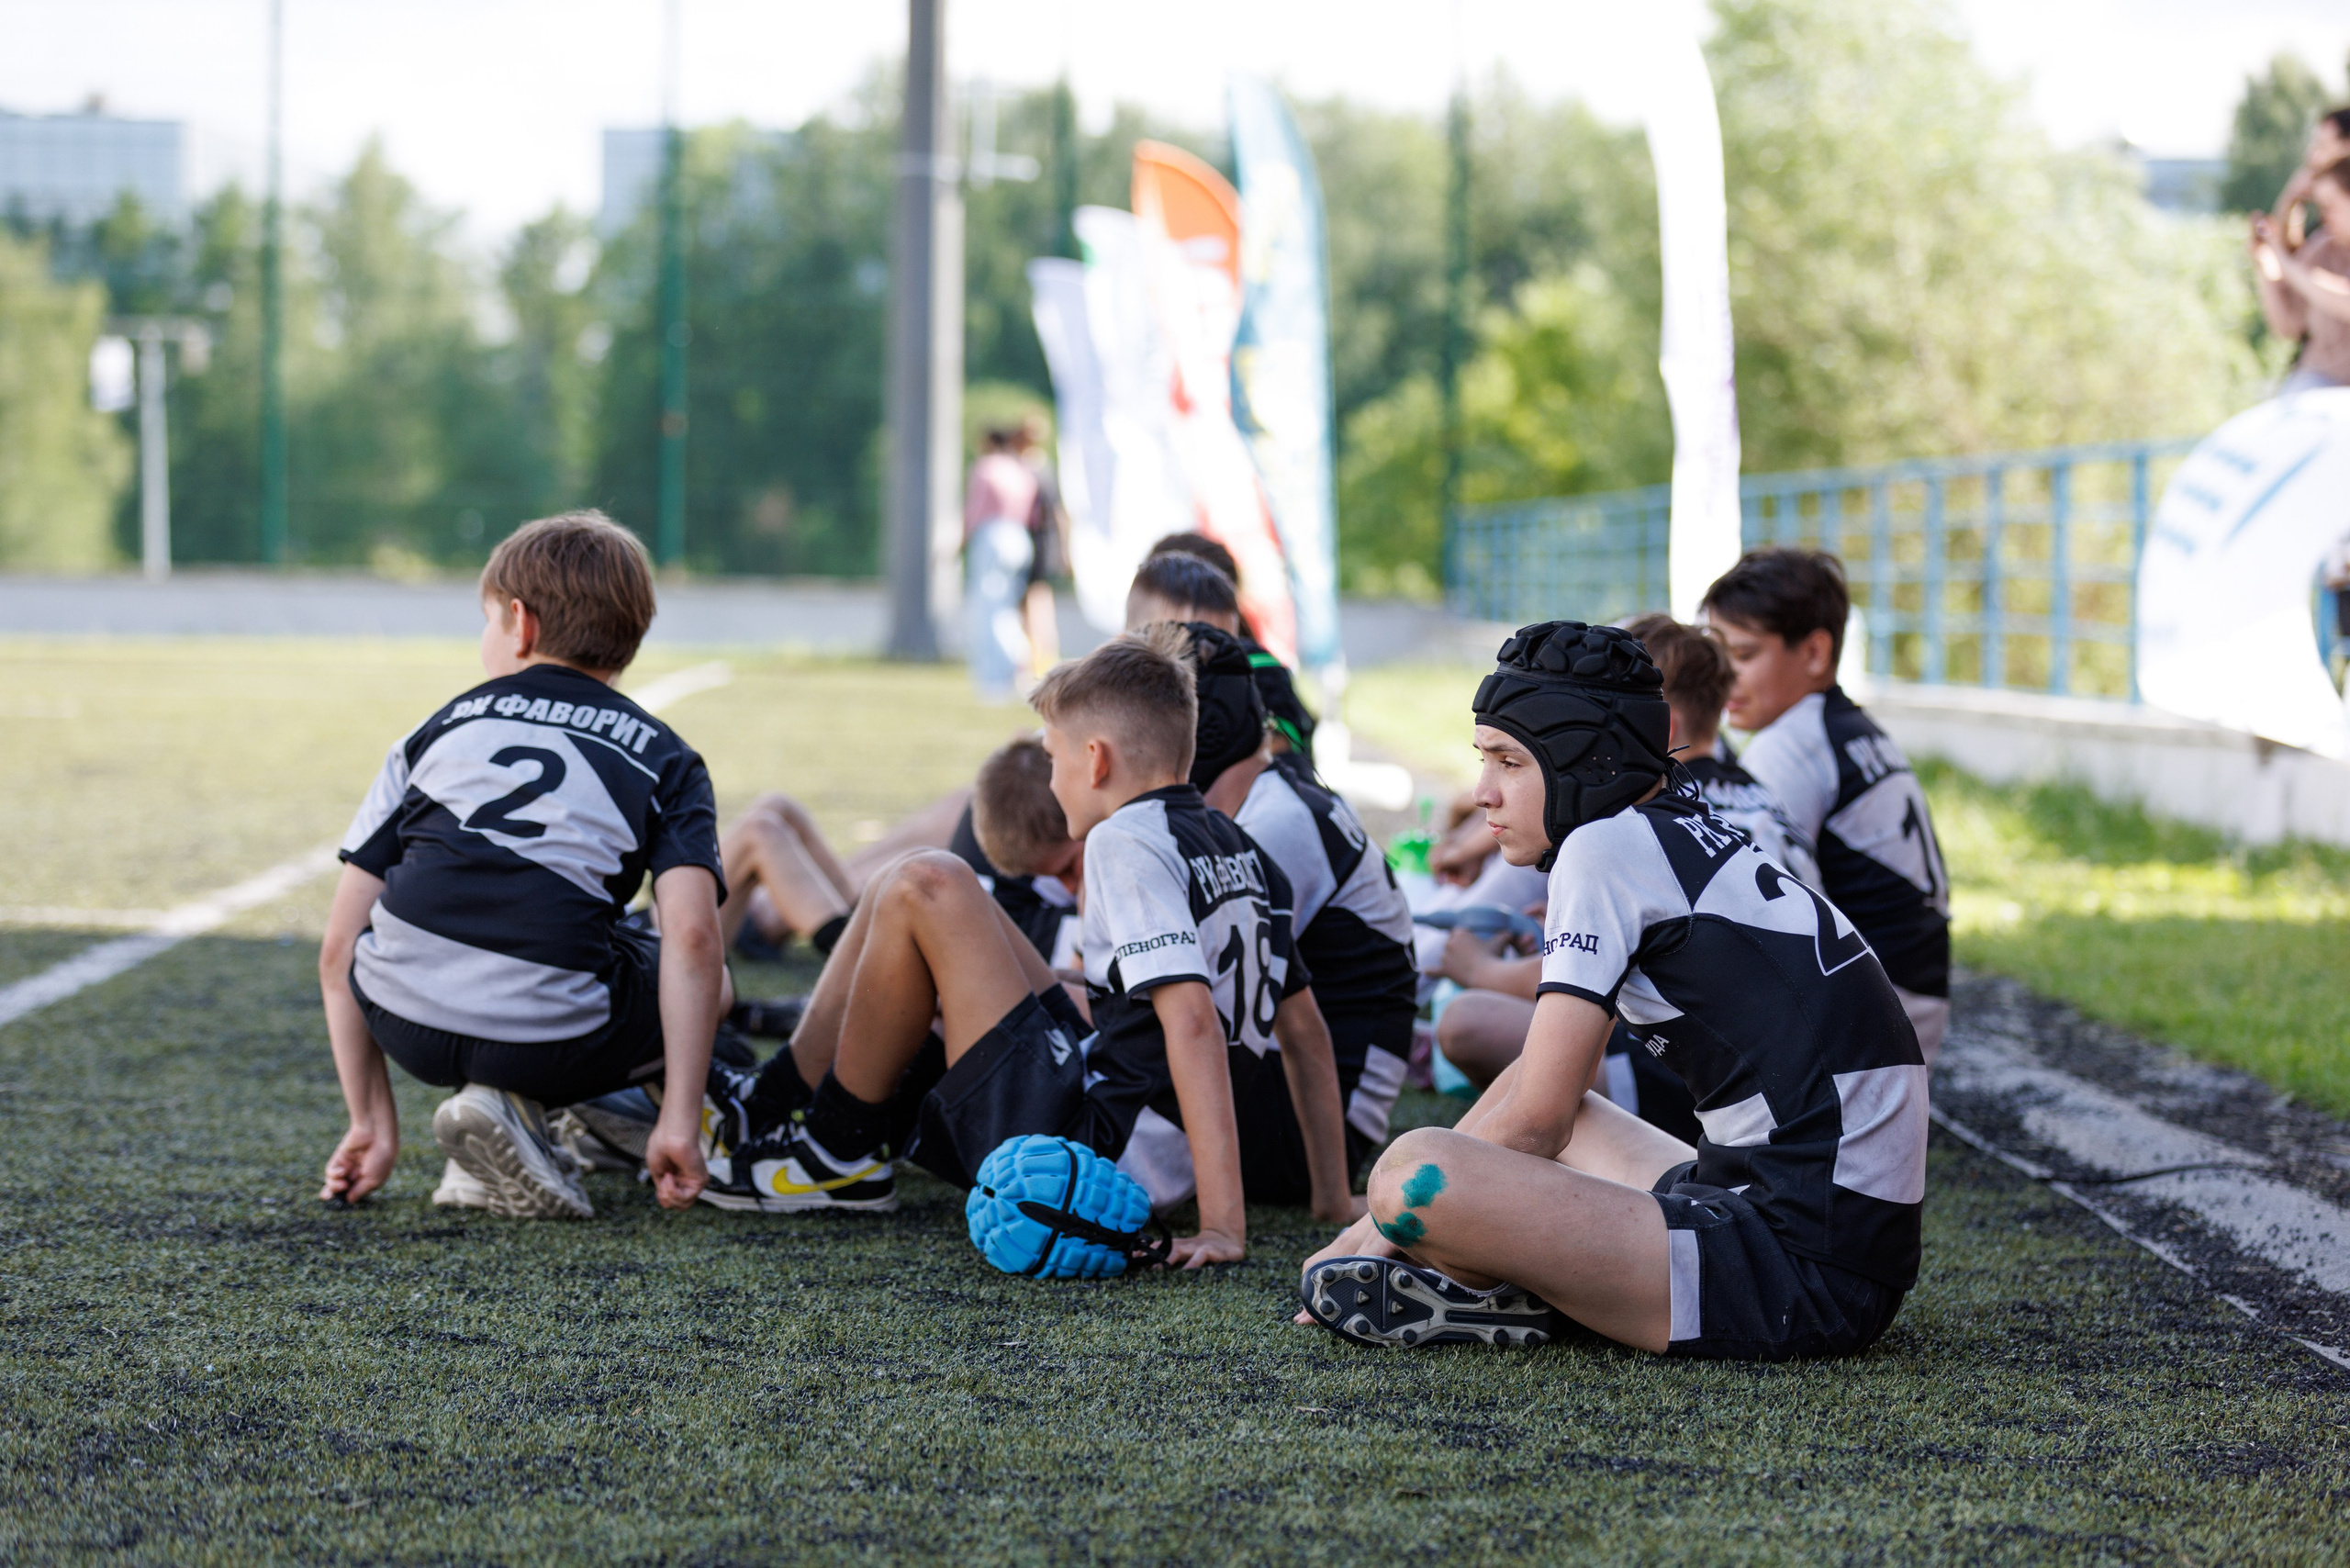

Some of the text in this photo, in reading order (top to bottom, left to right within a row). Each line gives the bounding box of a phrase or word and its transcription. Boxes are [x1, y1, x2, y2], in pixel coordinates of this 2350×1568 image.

[493, 693, 659, 755] ФАВОРИТ
[464, 745, 567, 838] 2
[1673, 813, 1732, 858] РК
[1217, 921, 1282, 1043] 18
